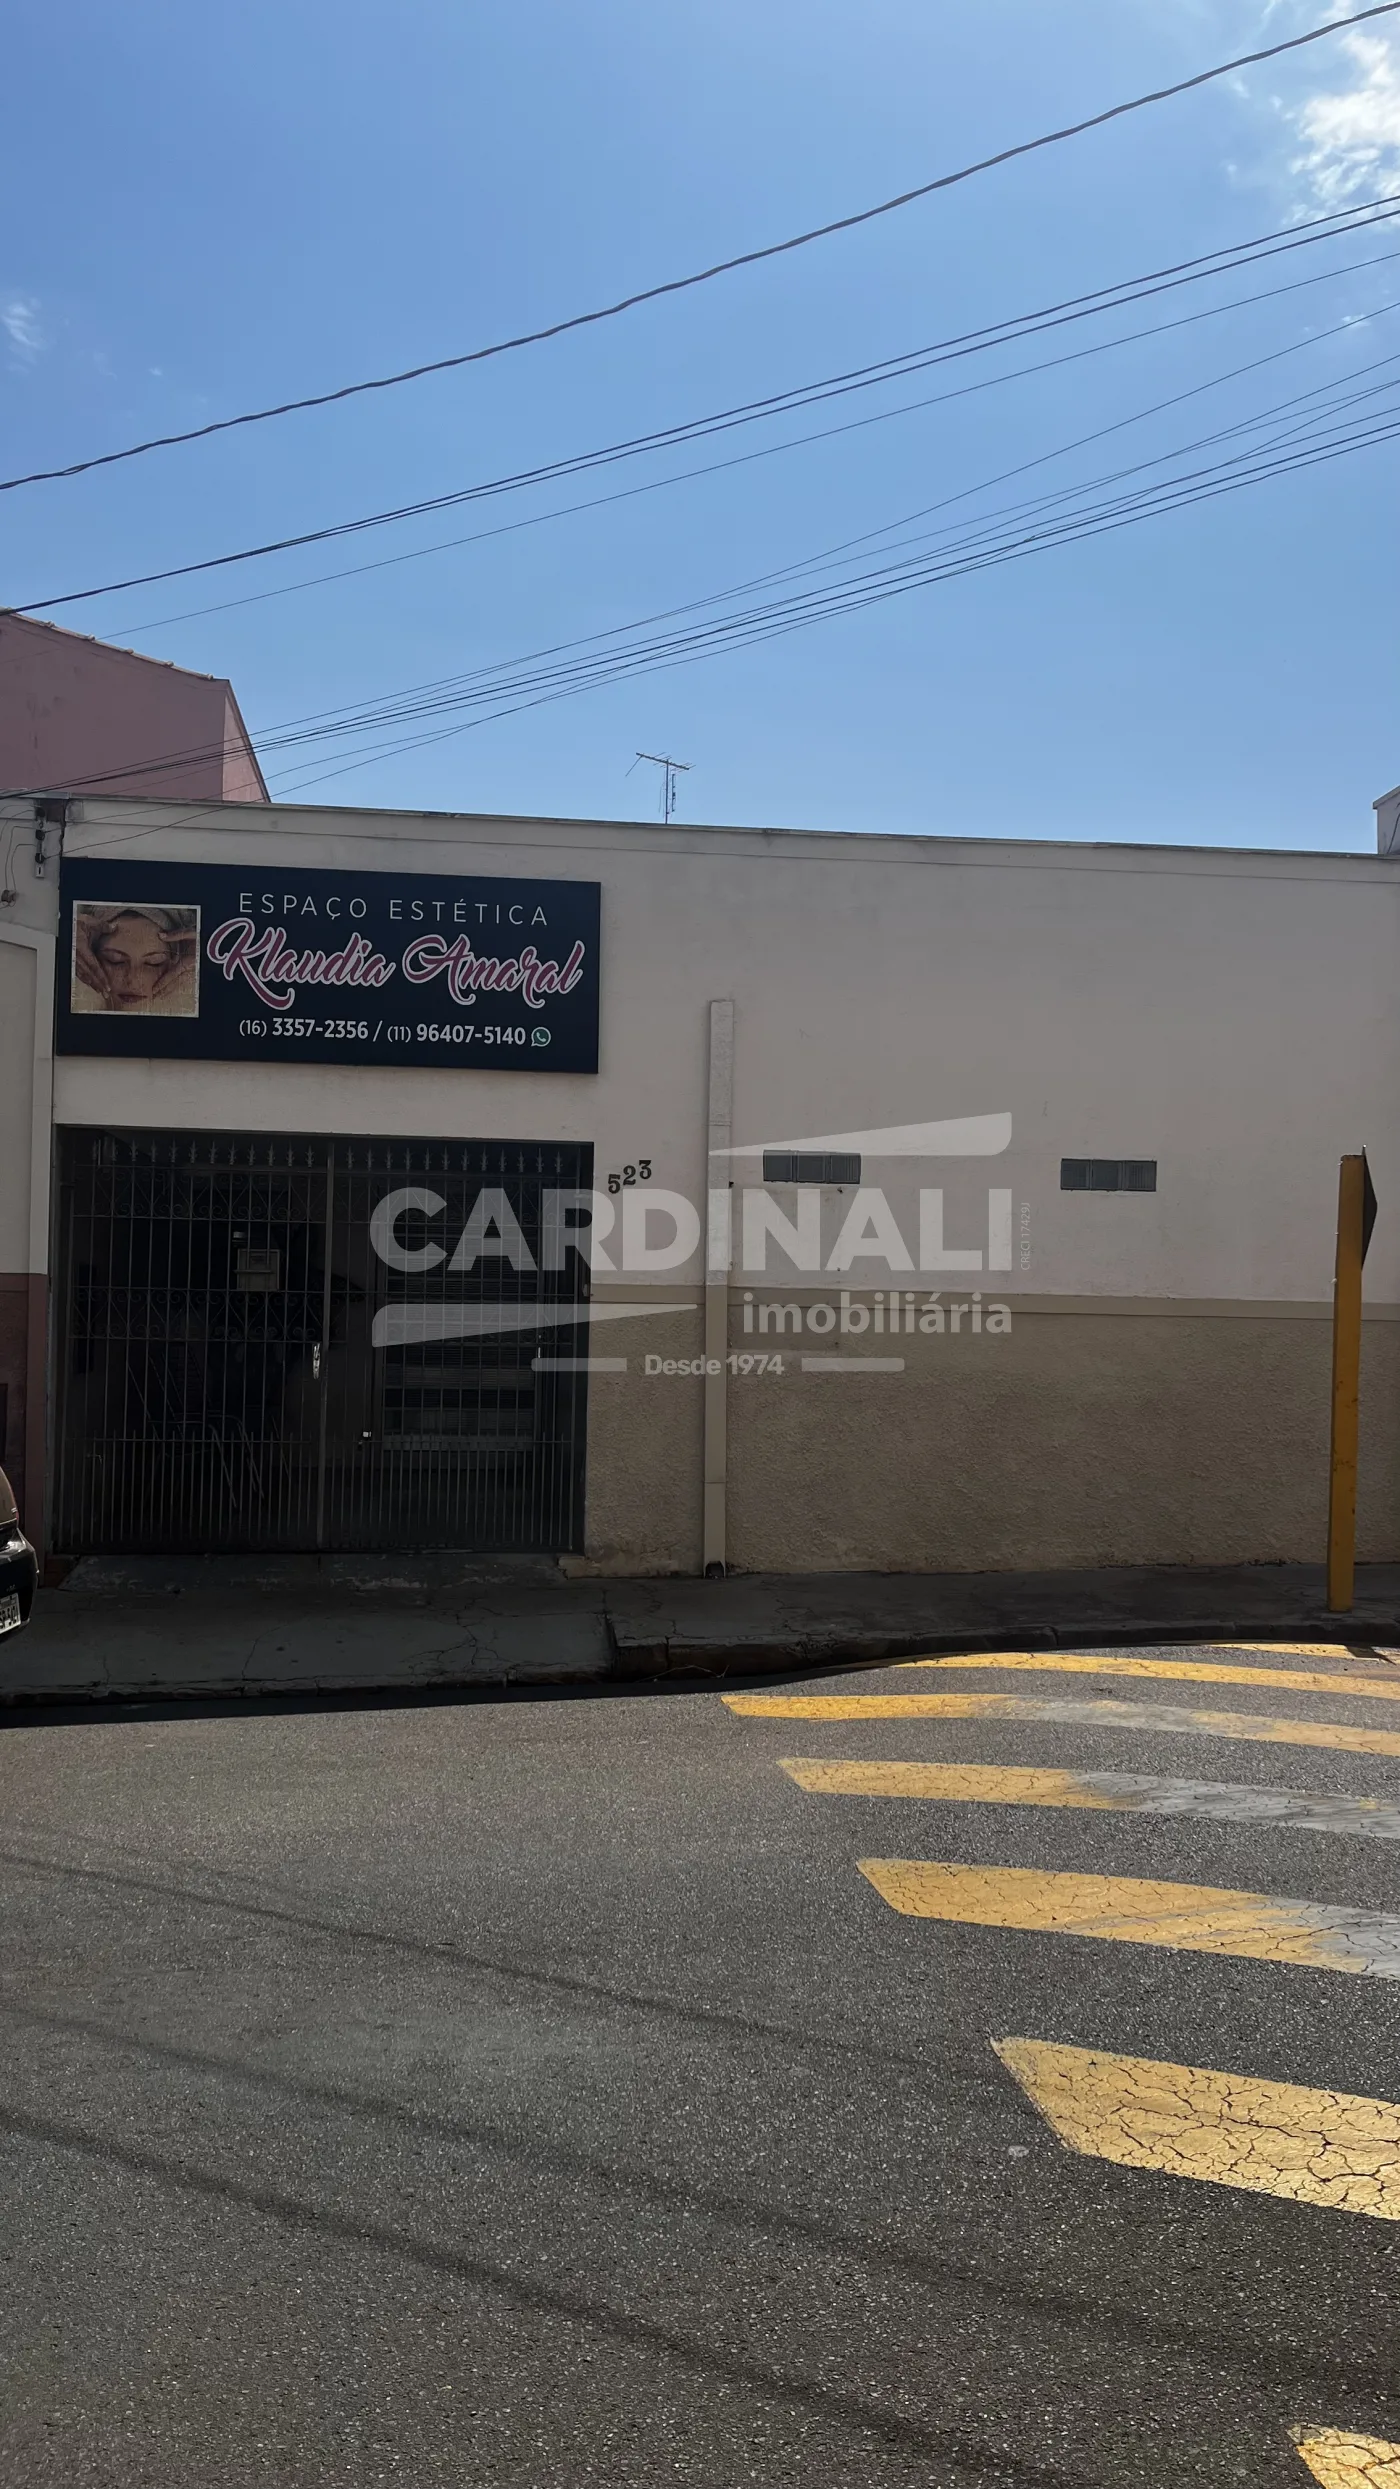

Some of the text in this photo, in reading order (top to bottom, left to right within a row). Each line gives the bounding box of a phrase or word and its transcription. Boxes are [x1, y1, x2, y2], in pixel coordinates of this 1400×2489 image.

[239, 892, 548, 926] ESPAÇO ESTÉTICA
[206, 917, 585, 1010] Klaudia Amaral
[239, 1017, 526, 1046] (16) 3357-2356 / (11) 96407-5140
[607, 1159, 653, 1195] 523
